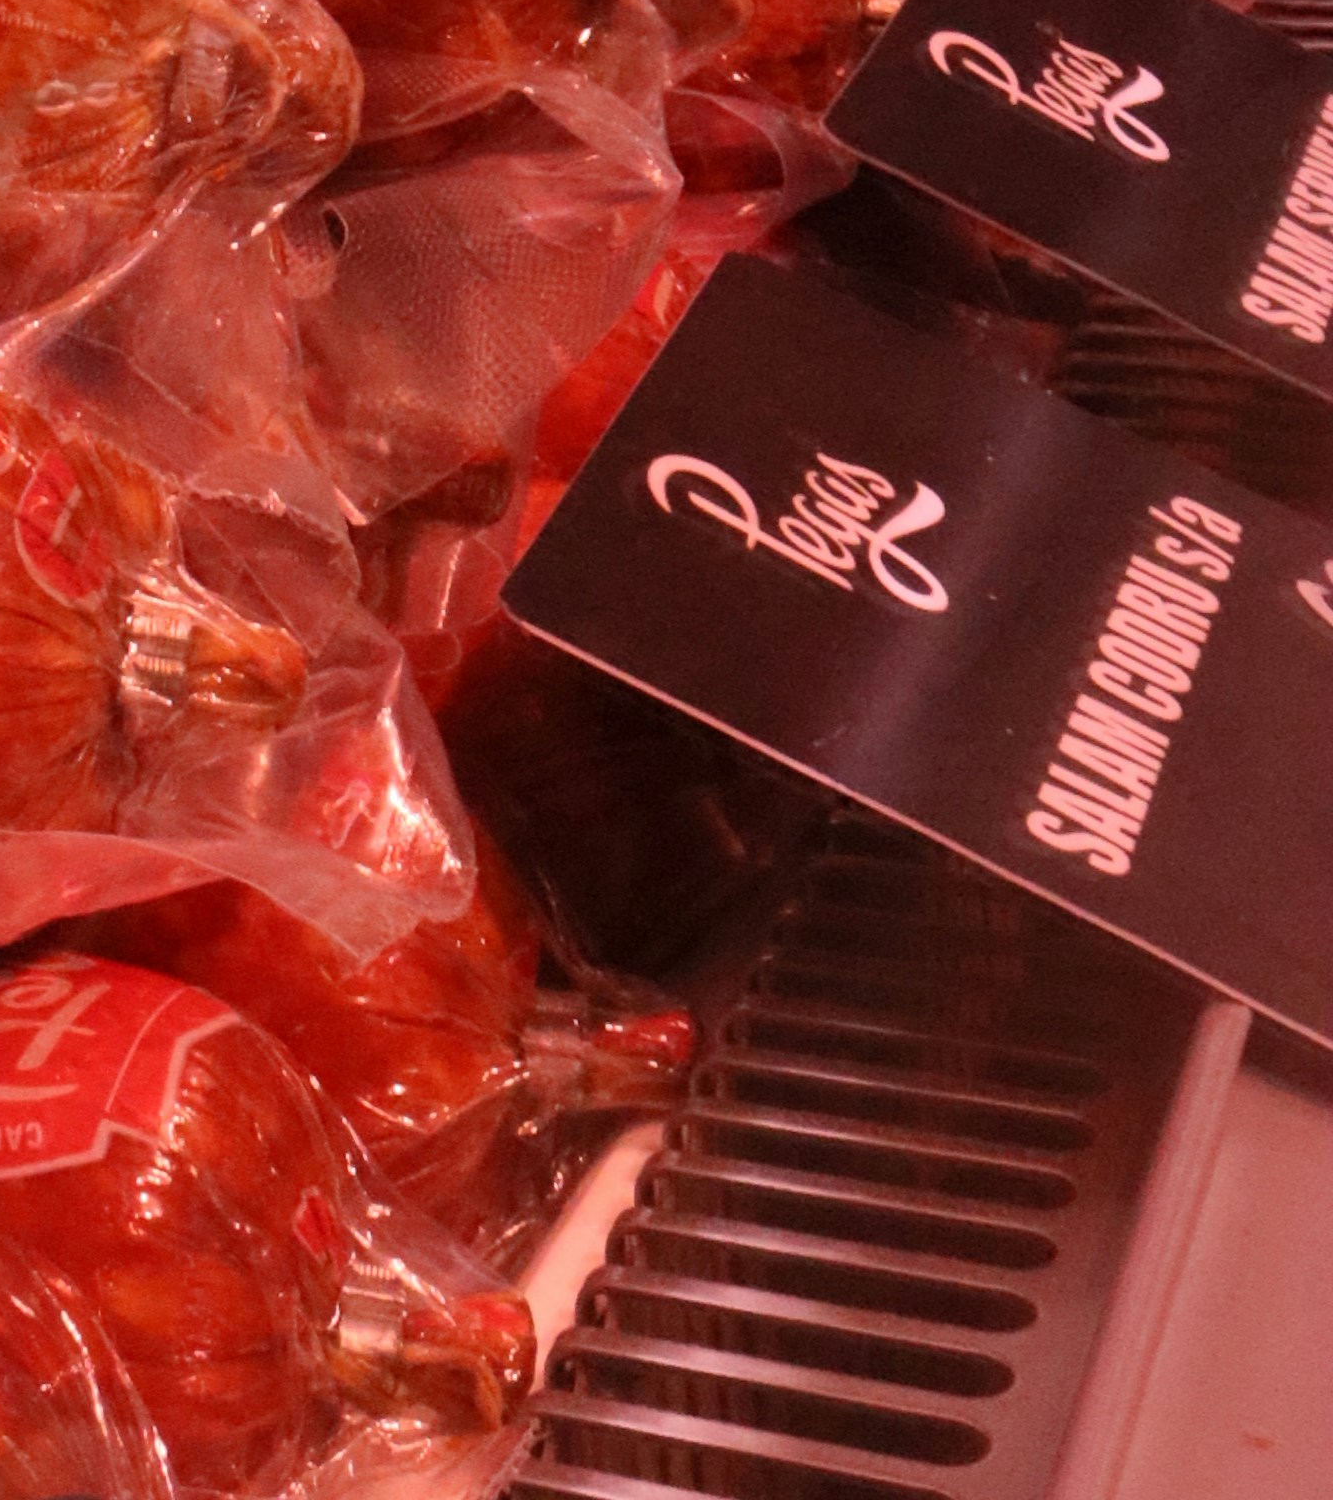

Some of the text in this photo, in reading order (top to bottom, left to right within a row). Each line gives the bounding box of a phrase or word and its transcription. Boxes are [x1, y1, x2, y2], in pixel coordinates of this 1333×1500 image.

[928, 30, 1171, 162] Pegas
[646, 450, 950, 614] Pegas
[1026, 494, 1244, 878] SALAM CODRU s/a
